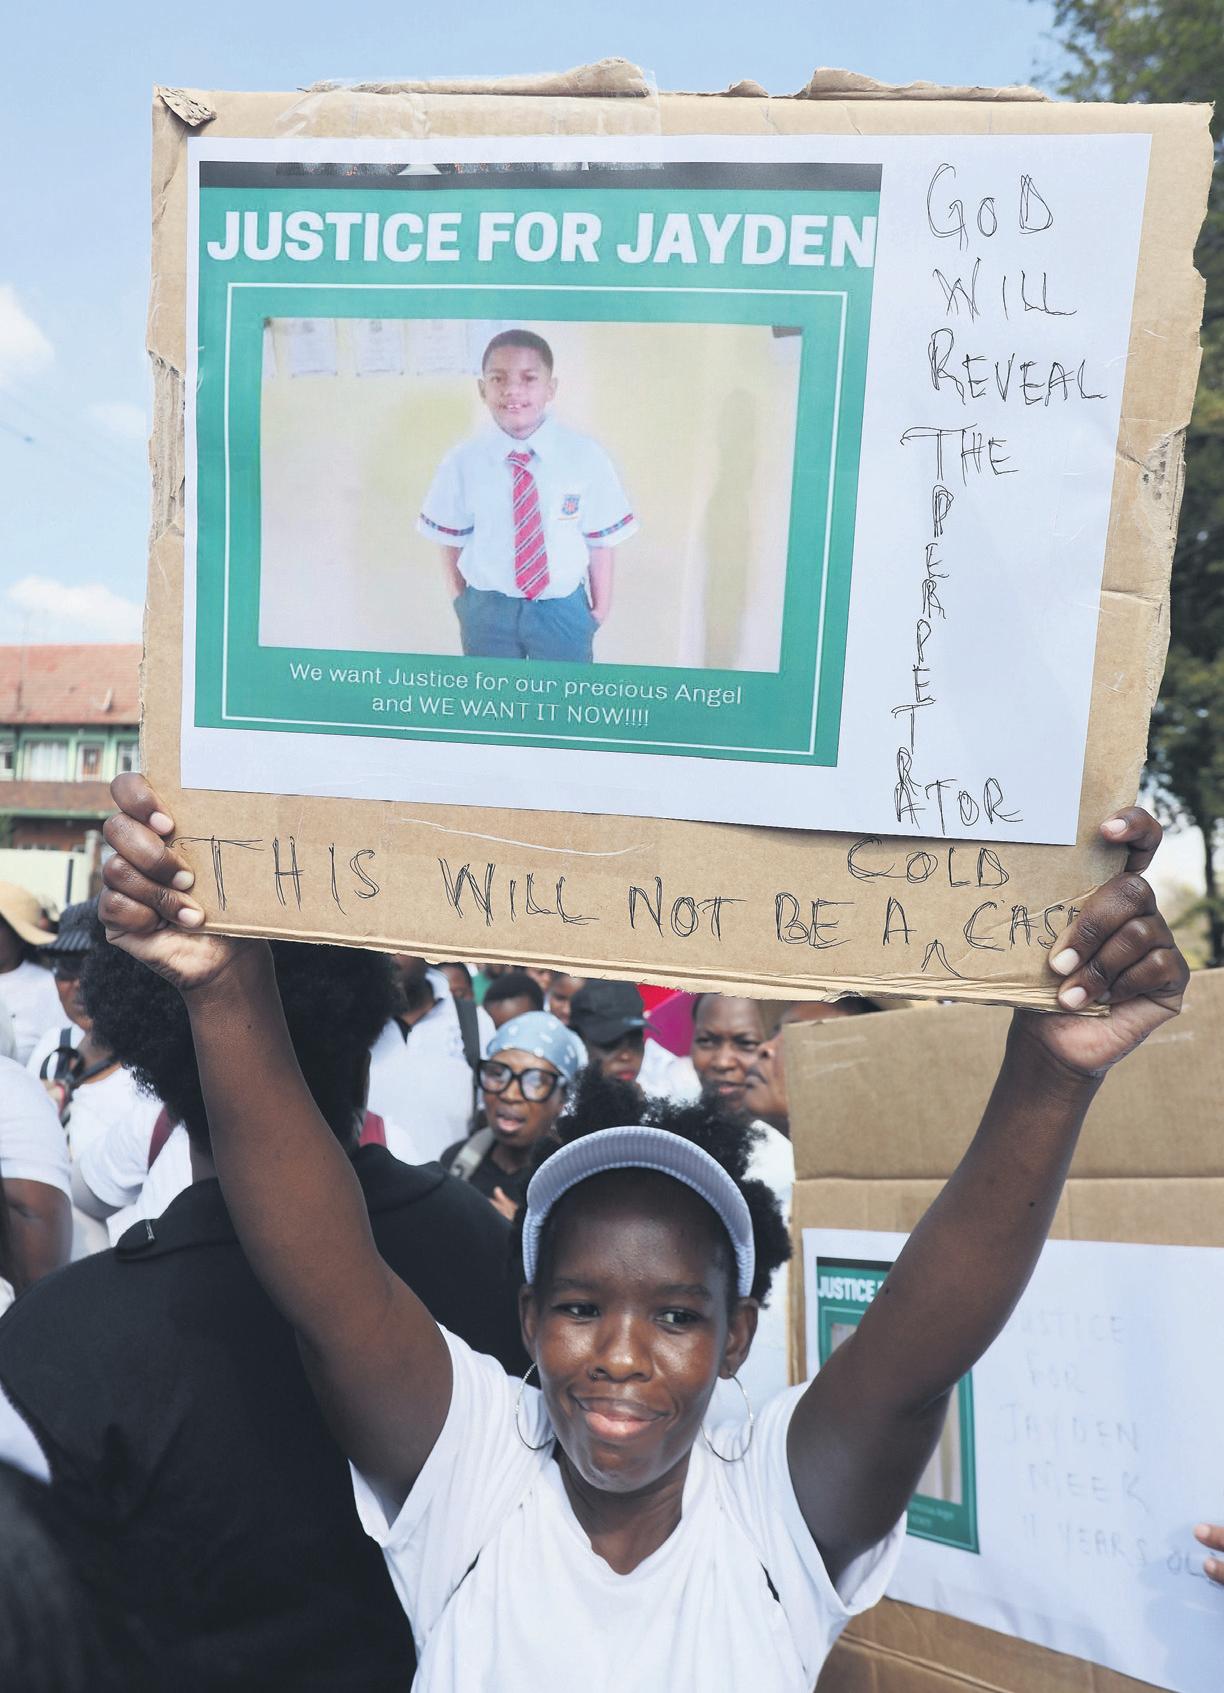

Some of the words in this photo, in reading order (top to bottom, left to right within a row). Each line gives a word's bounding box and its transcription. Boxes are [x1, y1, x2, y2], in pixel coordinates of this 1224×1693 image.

[927, 163, 1053, 251] GOD
[207, 211, 463, 262] JUSTICE
[478, 211, 602, 263] FOR
[617, 212, 878, 268] JAYDEN
[933, 257, 1077, 323] WILL
[928, 327, 1108, 406] REVEAL
[900, 423, 1019, 487] THE
[290, 663, 322, 681] We
[329, 667, 382, 685] want
[389, 668, 468, 688] Justice
[476, 671, 509, 691] for
[516, 678, 557, 693] our
[564, 681, 668, 700] precious
[675, 684, 741, 707] Angel
[372, 695, 412, 712] and
[419, 696, 456, 715] WE
[461, 699, 529, 720] WANT
[537, 704, 560, 720] IT
[567, 705, 649, 726] NOW!!!!
[846, 836, 1010, 888] COLD
[170, 835, 380, 917] THIS
[438, 857, 600, 927] WILL
[629, 876, 748, 941] NOT
[775, 891, 855, 950] BE
[882, 896, 917, 946] A
[817, 1276, 876, 1303] JUSTICE
